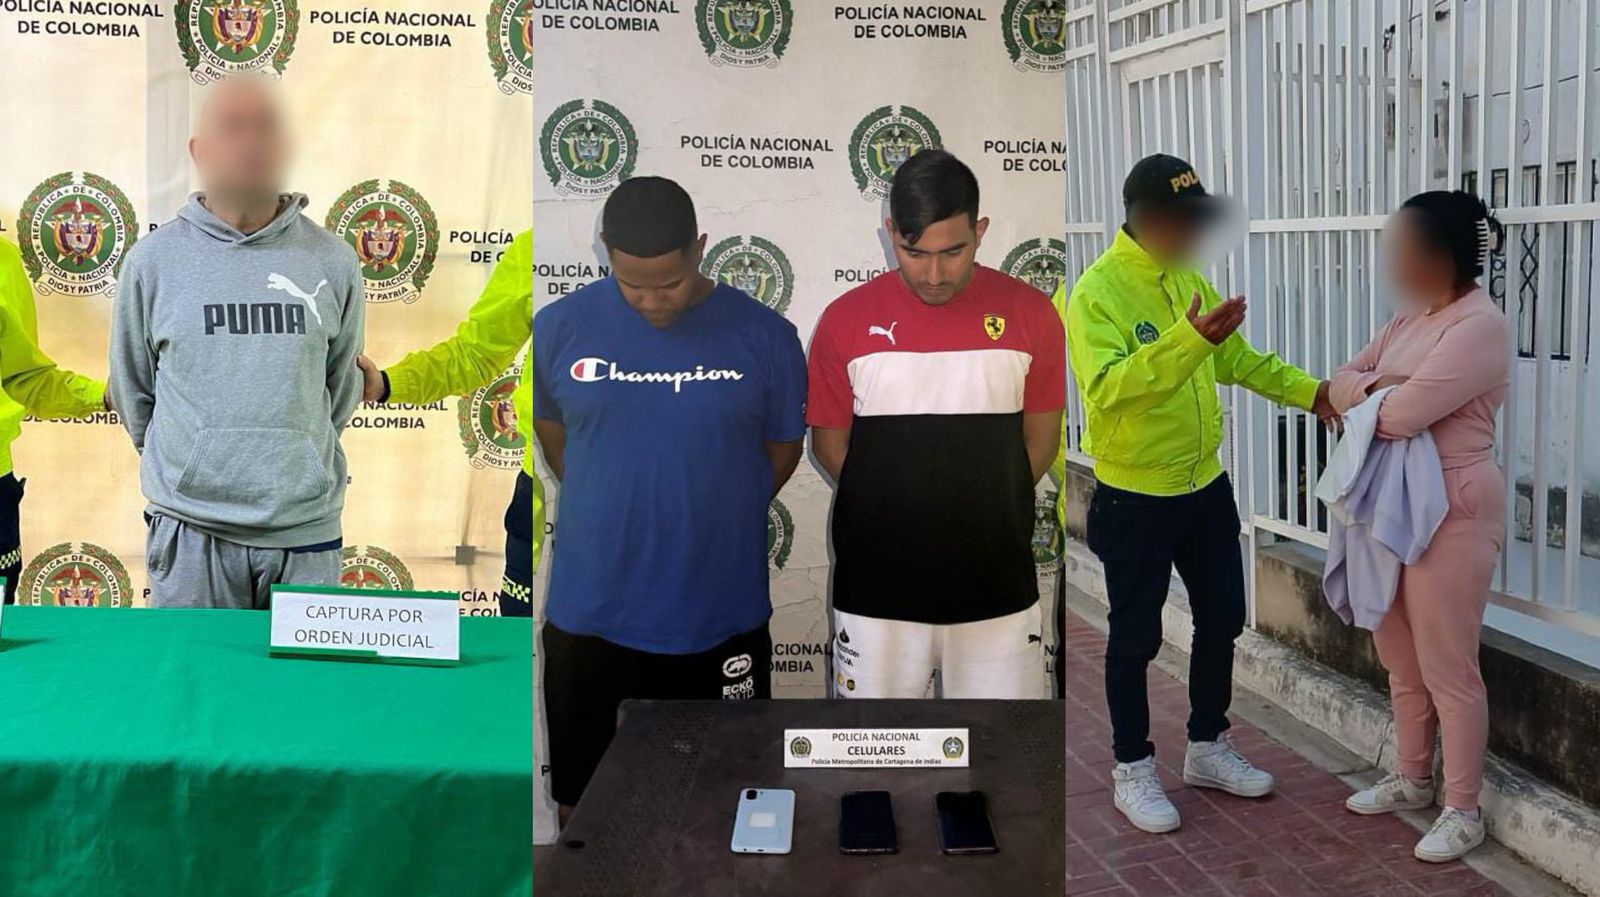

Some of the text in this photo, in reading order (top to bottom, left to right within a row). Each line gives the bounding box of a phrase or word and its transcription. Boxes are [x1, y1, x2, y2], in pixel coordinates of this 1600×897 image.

[69, 1, 164, 17] NACIONAL
[593, 0, 680, 13] NACIONAL
[835, 4, 987, 21] POLICÍA NACIONAL
[310, 8, 476, 27] POLICÍA NACIONAL
[542, 15, 660, 31] DE COLOMBIA
[18, 20, 140, 37] DE COLOMBIA
[854, 25, 967, 39] DE COLOMBIA
[332, 31, 451, 47] DE COLOMBIA
[681, 134, 834, 152] POLICÍA NACIONAL
[984, 138, 1047, 154] POLICÍA
[701, 154, 815, 169] DE COLOMBIA
[1003, 159, 1025, 171] DE
[450, 229, 514, 244] POLICÍA
[470, 251, 491, 263] DE
[548, 282, 570, 295] DE
[203, 303, 306, 335] PUMA
[570, 357, 744, 393] Champion
[345, 417, 425, 429] OLOMBIA
[305, 605, 423, 623] CAPTURA POR
[294, 629, 434, 649] ORDEN JUDICIAL
[771, 643, 831, 656] CIONAL
[871, 732, 921, 741] NACIONAL
[847, 746, 906, 756] CELULARES
